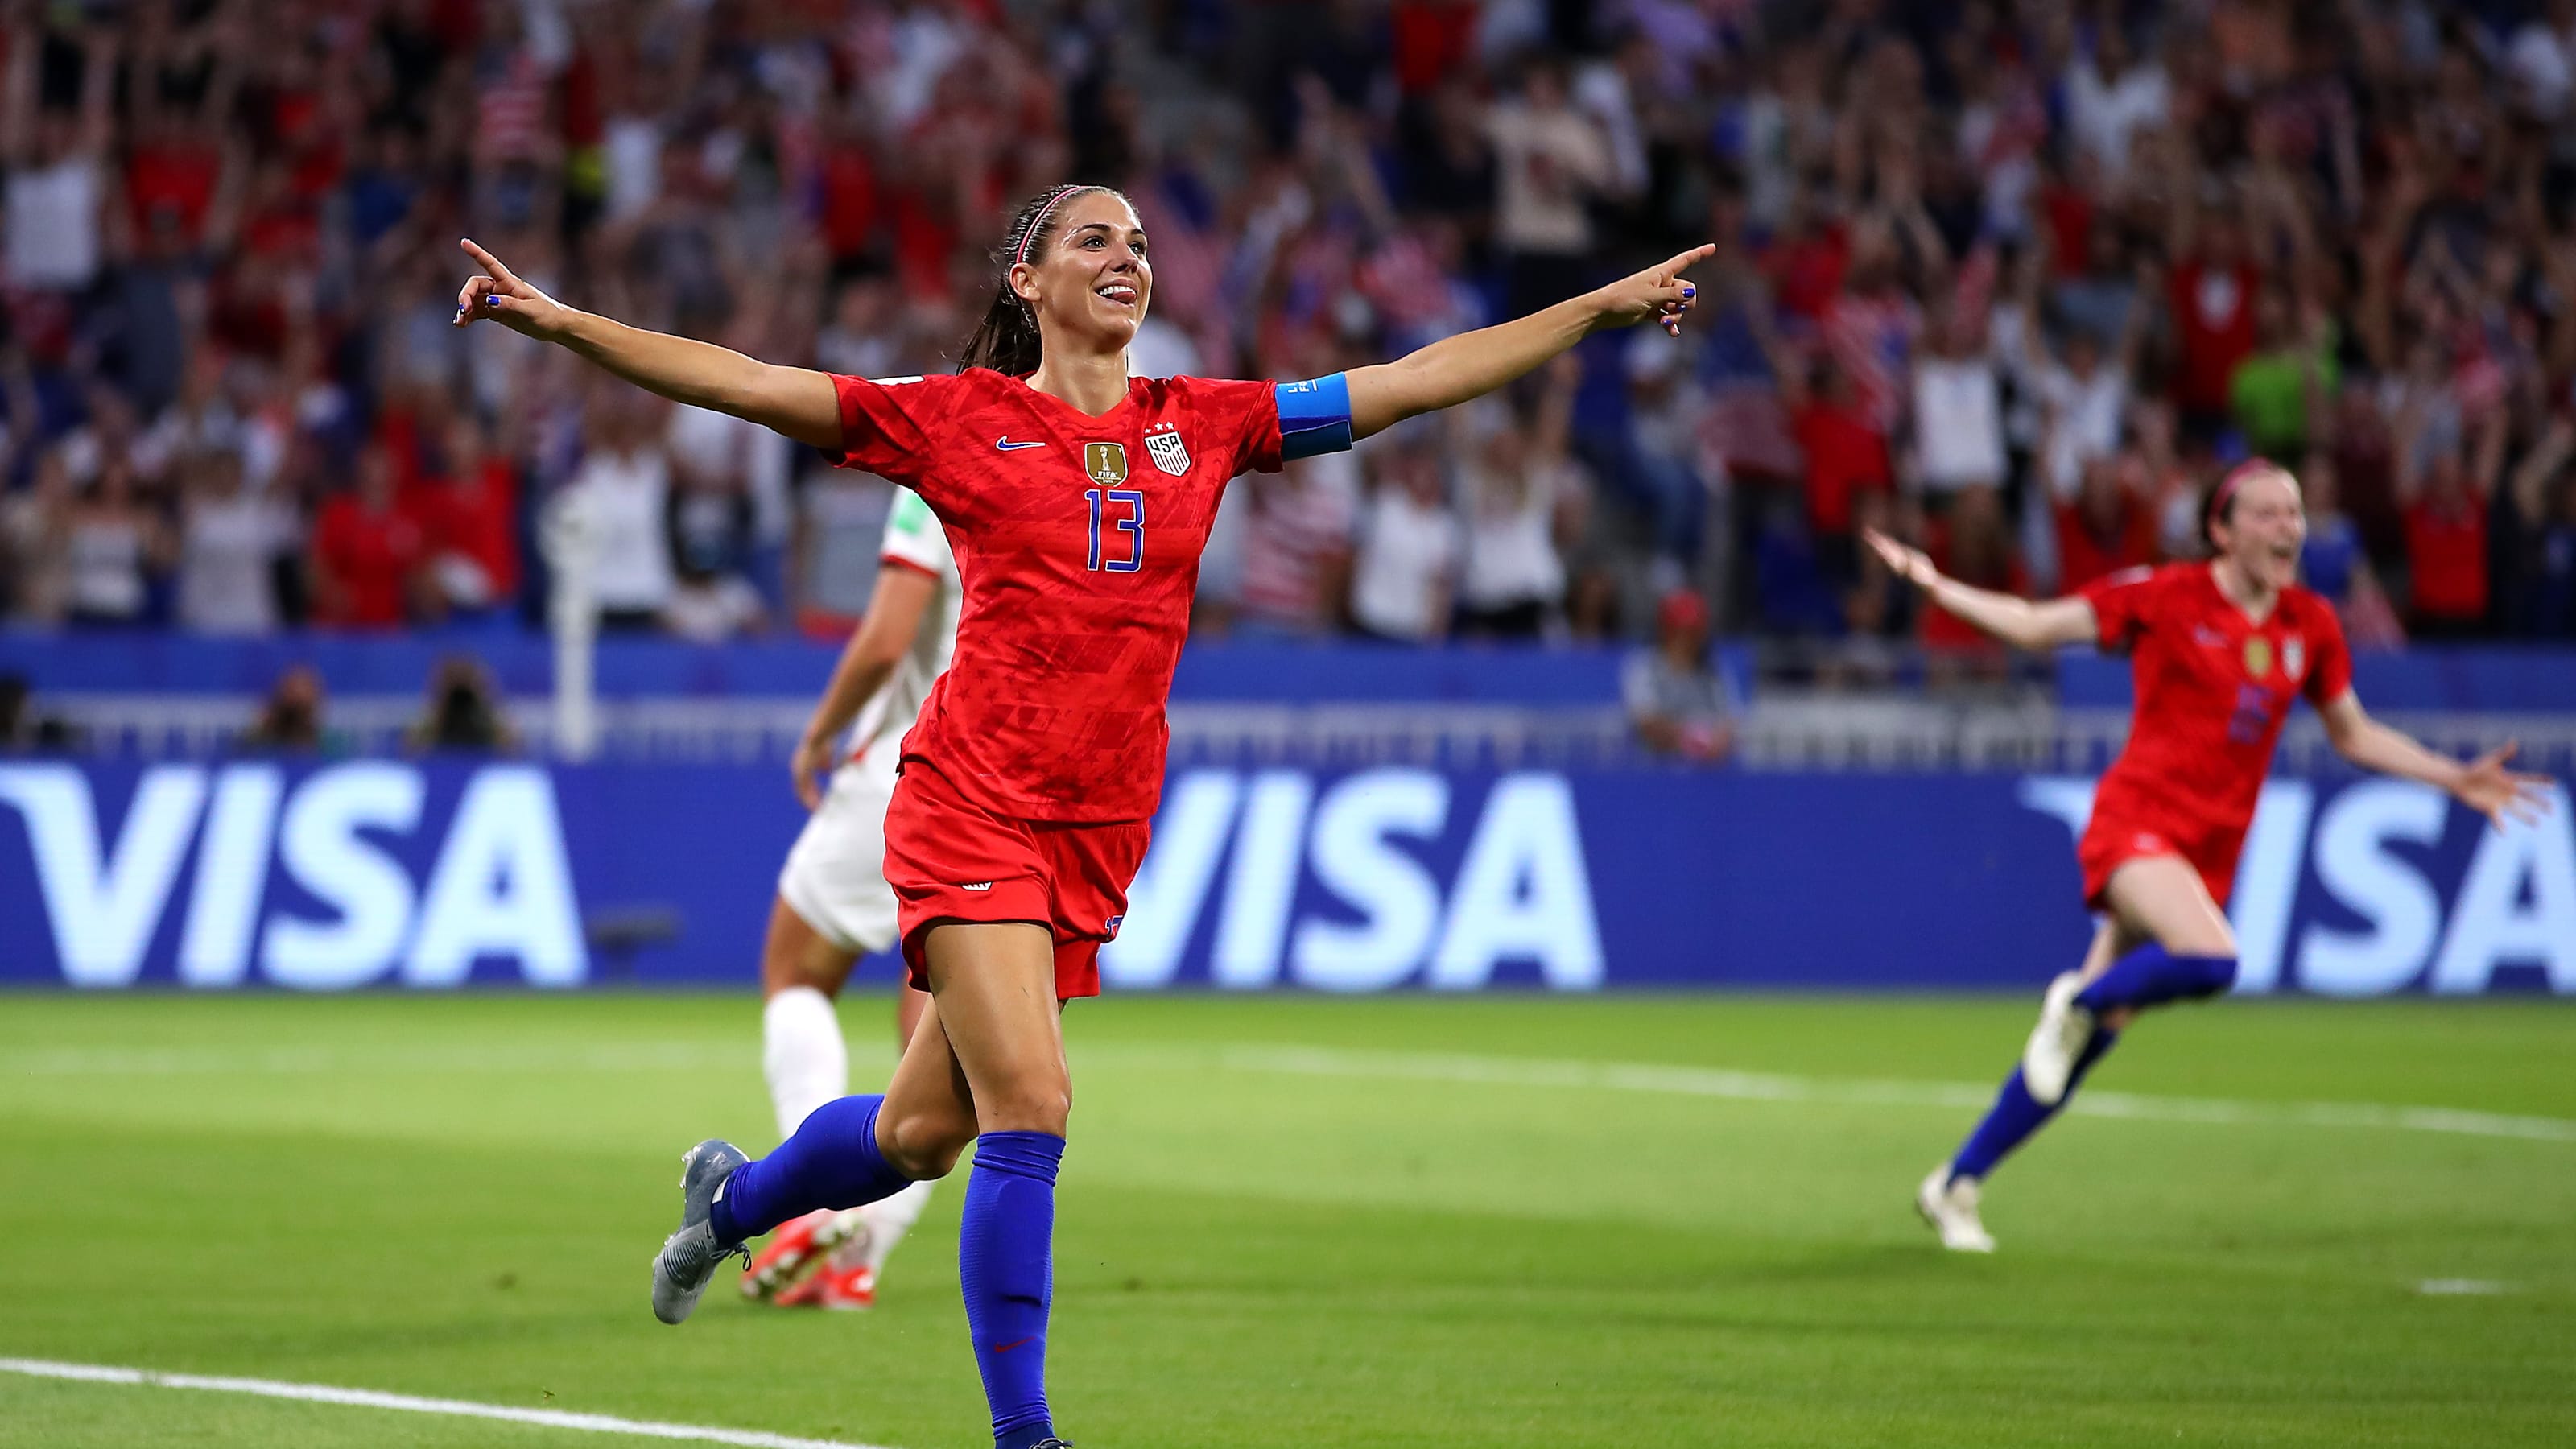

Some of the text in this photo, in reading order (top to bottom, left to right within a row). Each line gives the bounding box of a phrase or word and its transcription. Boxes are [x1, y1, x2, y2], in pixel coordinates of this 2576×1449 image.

[1148, 435, 1179, 453] USA
[1084, 489, 1144, 572] 13
[0, 762, 589, 989] VISA
[2019, 775, 2576, 995] ISA
